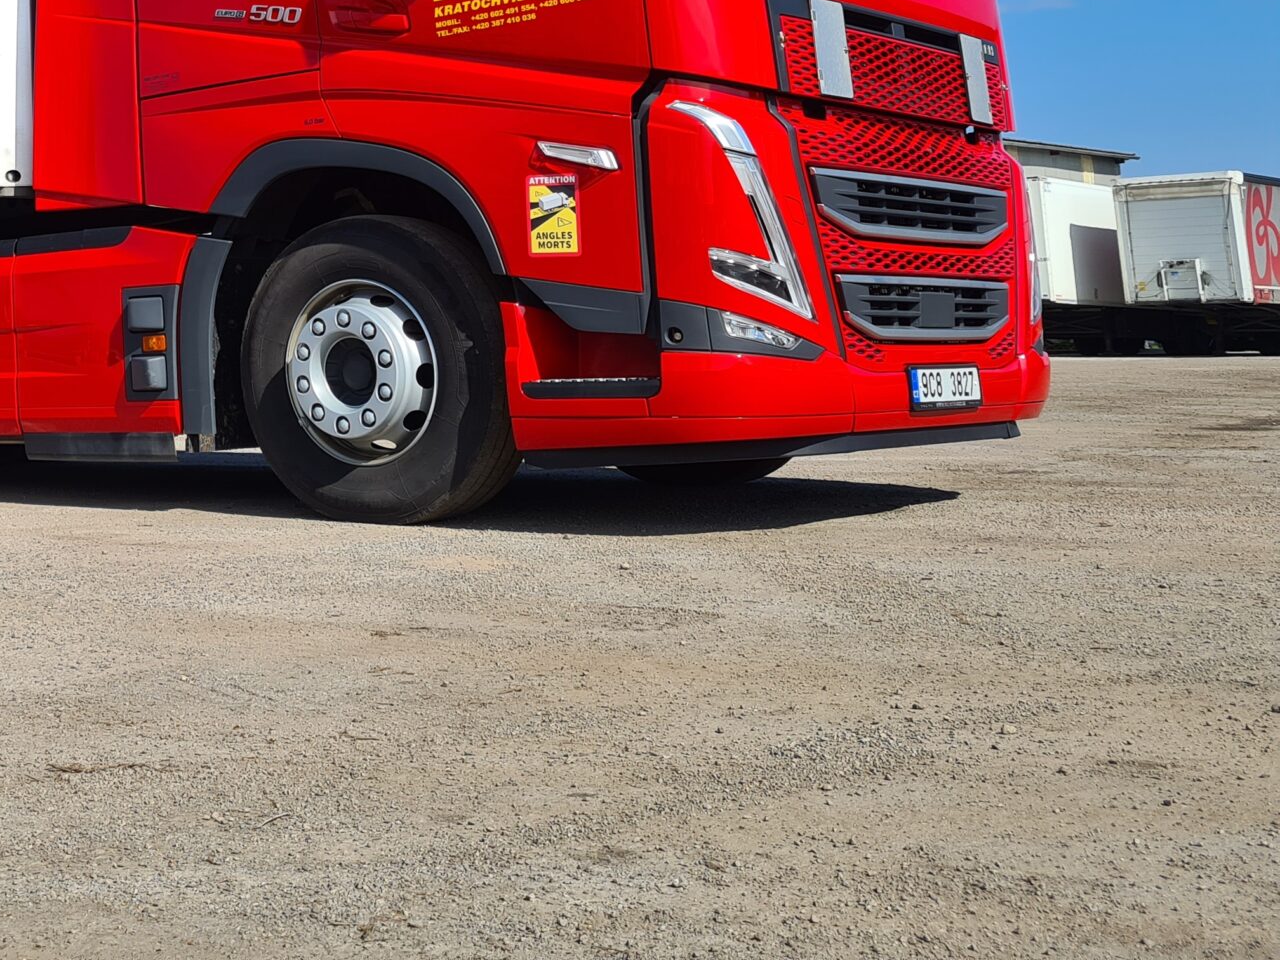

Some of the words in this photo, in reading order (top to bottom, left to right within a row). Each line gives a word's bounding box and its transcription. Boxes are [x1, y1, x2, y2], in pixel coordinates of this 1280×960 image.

[249, 4, 302, 24] 500
[435, 18, 462, 29] MOBIL:
[470, 11, 489, 22] +420
[490, 9, 504, 19] 602
[505, 6, 519, 16] 491
[472, 21, 490, 31] +420
[506, 15, 520, 26] 410
[528, 175, 576, 185] ATTENTION
[535, 231, 573, 240] ANGLES
[537, 240, 572, 249] MORTS
[921, 371, 943, 398] 9C8
[950, 370, 974, 397] 3827
